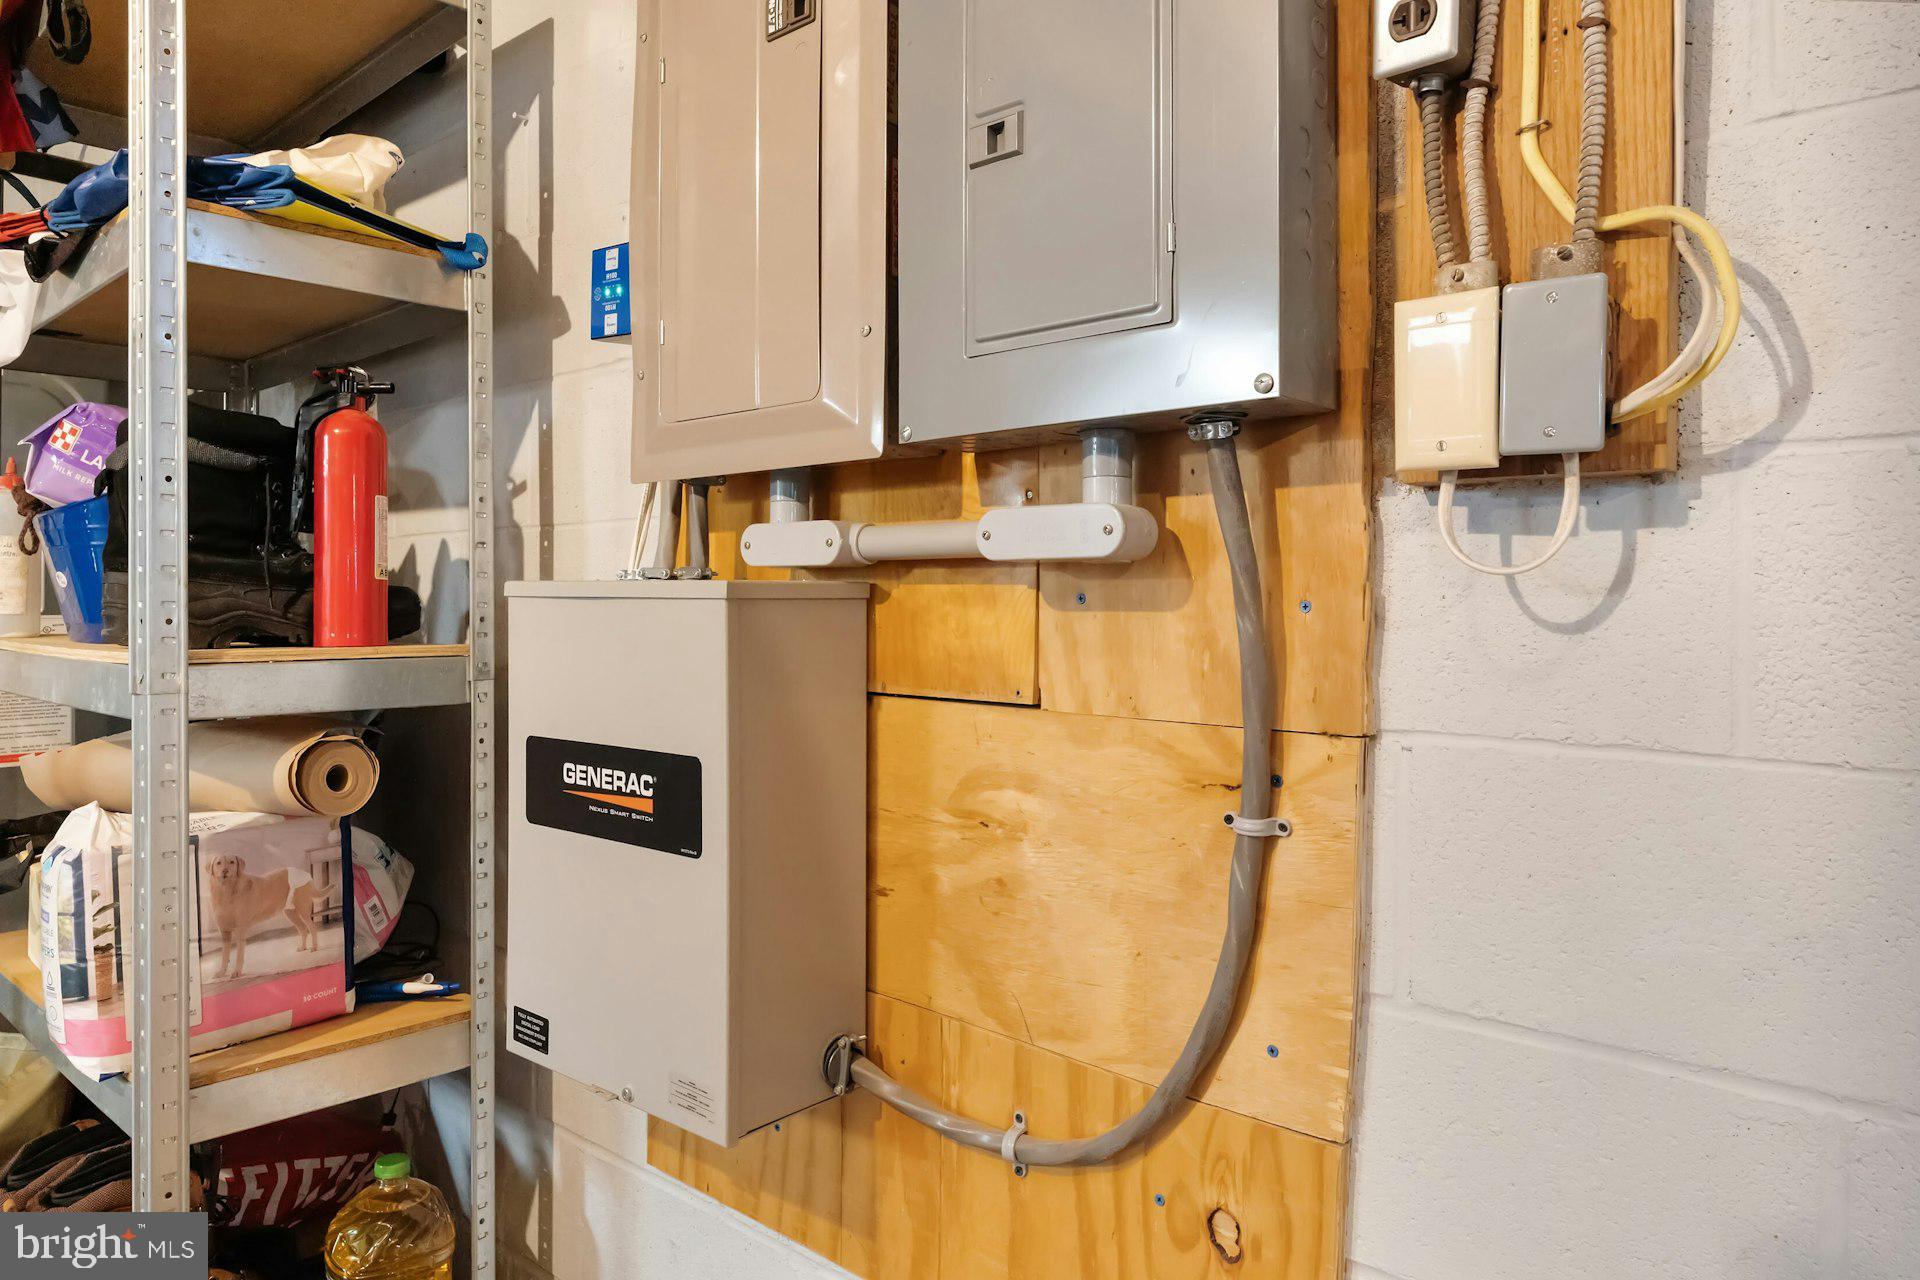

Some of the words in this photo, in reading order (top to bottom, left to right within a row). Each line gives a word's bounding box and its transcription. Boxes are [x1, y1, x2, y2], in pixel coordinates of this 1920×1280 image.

[80, 449, 107, 470] LA
[563, 762, 654, 797] GENERAC
[313, 987, 337, 999] COUNT
